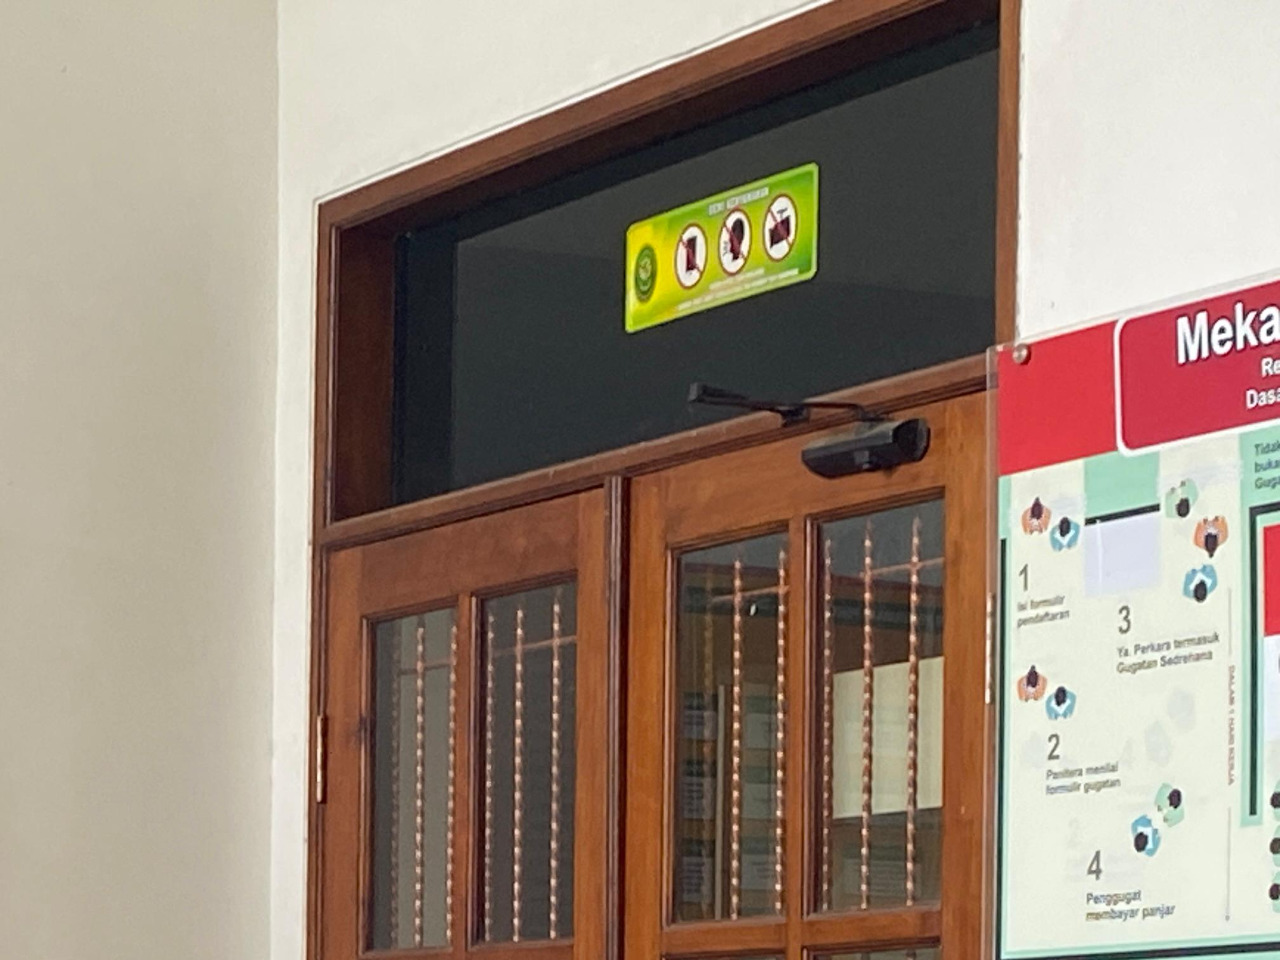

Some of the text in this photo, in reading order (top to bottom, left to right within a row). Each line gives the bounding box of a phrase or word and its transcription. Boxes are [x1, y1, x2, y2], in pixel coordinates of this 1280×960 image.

[1176, 301, 1280, 366] Meka
[1261, 357, 1280, 377] Re
[1018, 563, 1029, 592] 1
[1118, 605, 1131, 634] 3
[1133, 640, 1170, 656] Perkara
[1047, 733, 1061, 760] 2
[1087, 850, 1102, 881] 4
[1142, 904, 1176, 919] panjar
